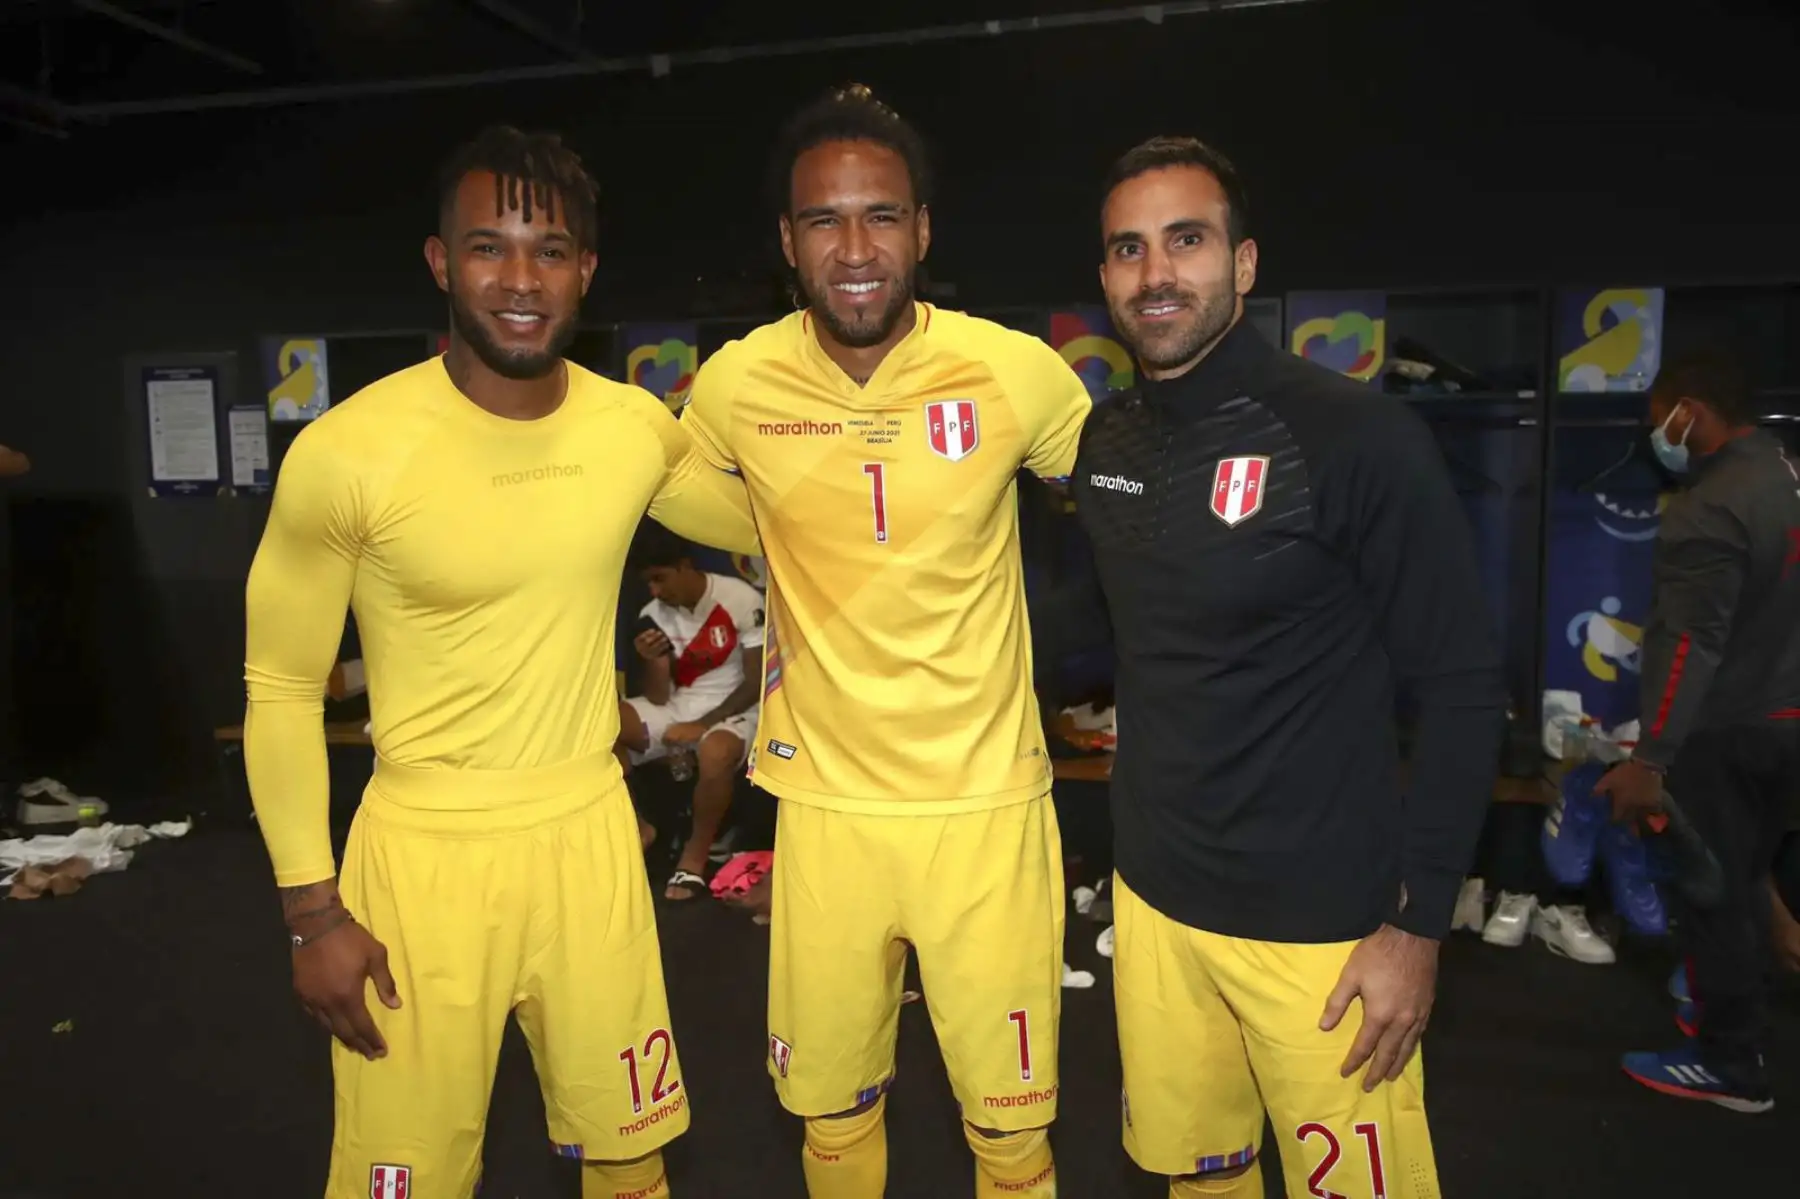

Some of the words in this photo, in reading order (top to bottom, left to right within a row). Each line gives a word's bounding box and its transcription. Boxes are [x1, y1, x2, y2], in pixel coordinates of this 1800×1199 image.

[758, 421, 842, 436] marathon
[492, 463, 584, 488] marathon
[863, 462, 887, 543] 1
[1090, 473, 1144, 496] marathon
[619, 1028, 681, 1115] 12
[1008, 1008, 1032, 1082] 1
[619, 1095, 686, 1137] marathon
[1296, 1121, 1388, 1199] 21
